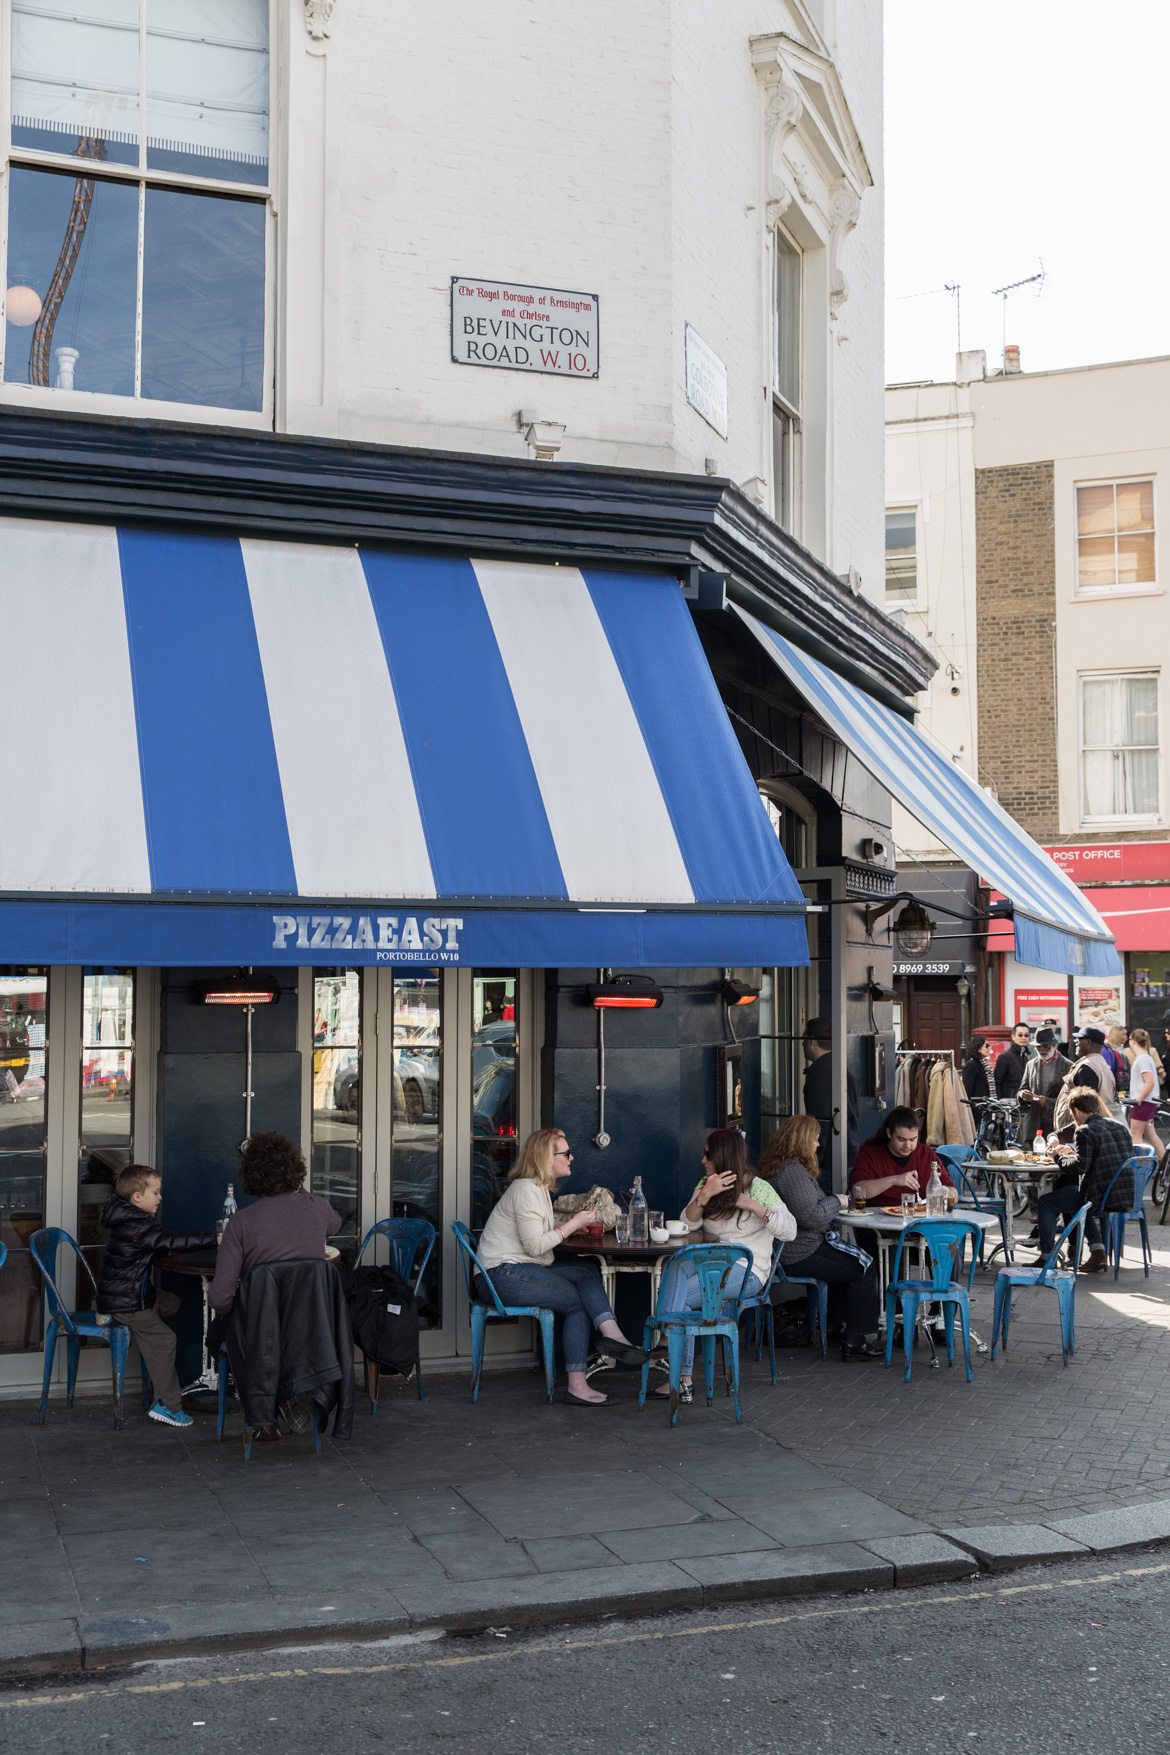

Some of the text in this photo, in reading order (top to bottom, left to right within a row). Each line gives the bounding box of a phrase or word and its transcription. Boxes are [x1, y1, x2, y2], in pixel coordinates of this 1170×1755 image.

[458, 285, 592, 313] The Royal Borough of Kensington
[501, 308, 551, 322] and Chelsea
[463, 316, 590, 348] BEVINGTON
[466, 341, 533, 367] ROAD,
[1053, 851, 1080, 861] POST
[1082, 849, 1121, 860] OFFICE
[376, 951, 460, 961] PORTOBELLO W10
[899, 964, 923, 973] 8969
[925, 963, 950, 973] 3539
